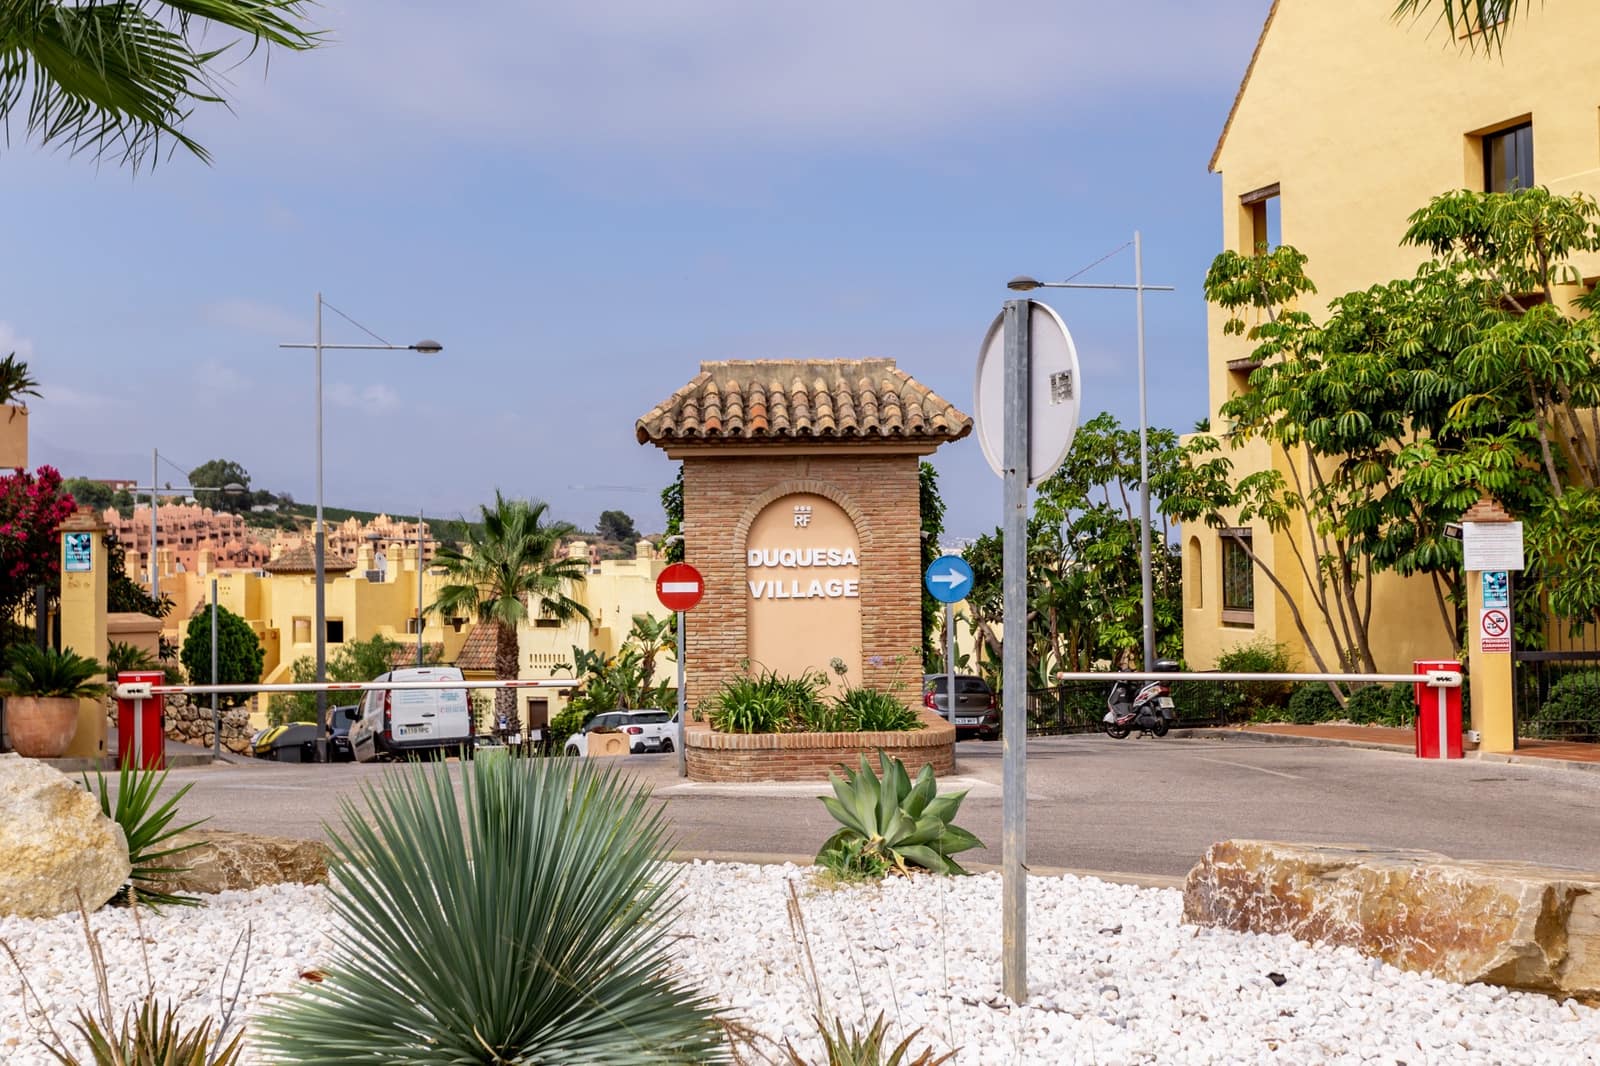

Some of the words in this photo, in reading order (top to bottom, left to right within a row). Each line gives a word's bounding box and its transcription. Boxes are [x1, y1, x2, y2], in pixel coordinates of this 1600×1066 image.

[794, 515, 811, 526] RF
[747, 548, 858, 567] DUQUESA
[748, 580, 859, 598] VILLAGE
